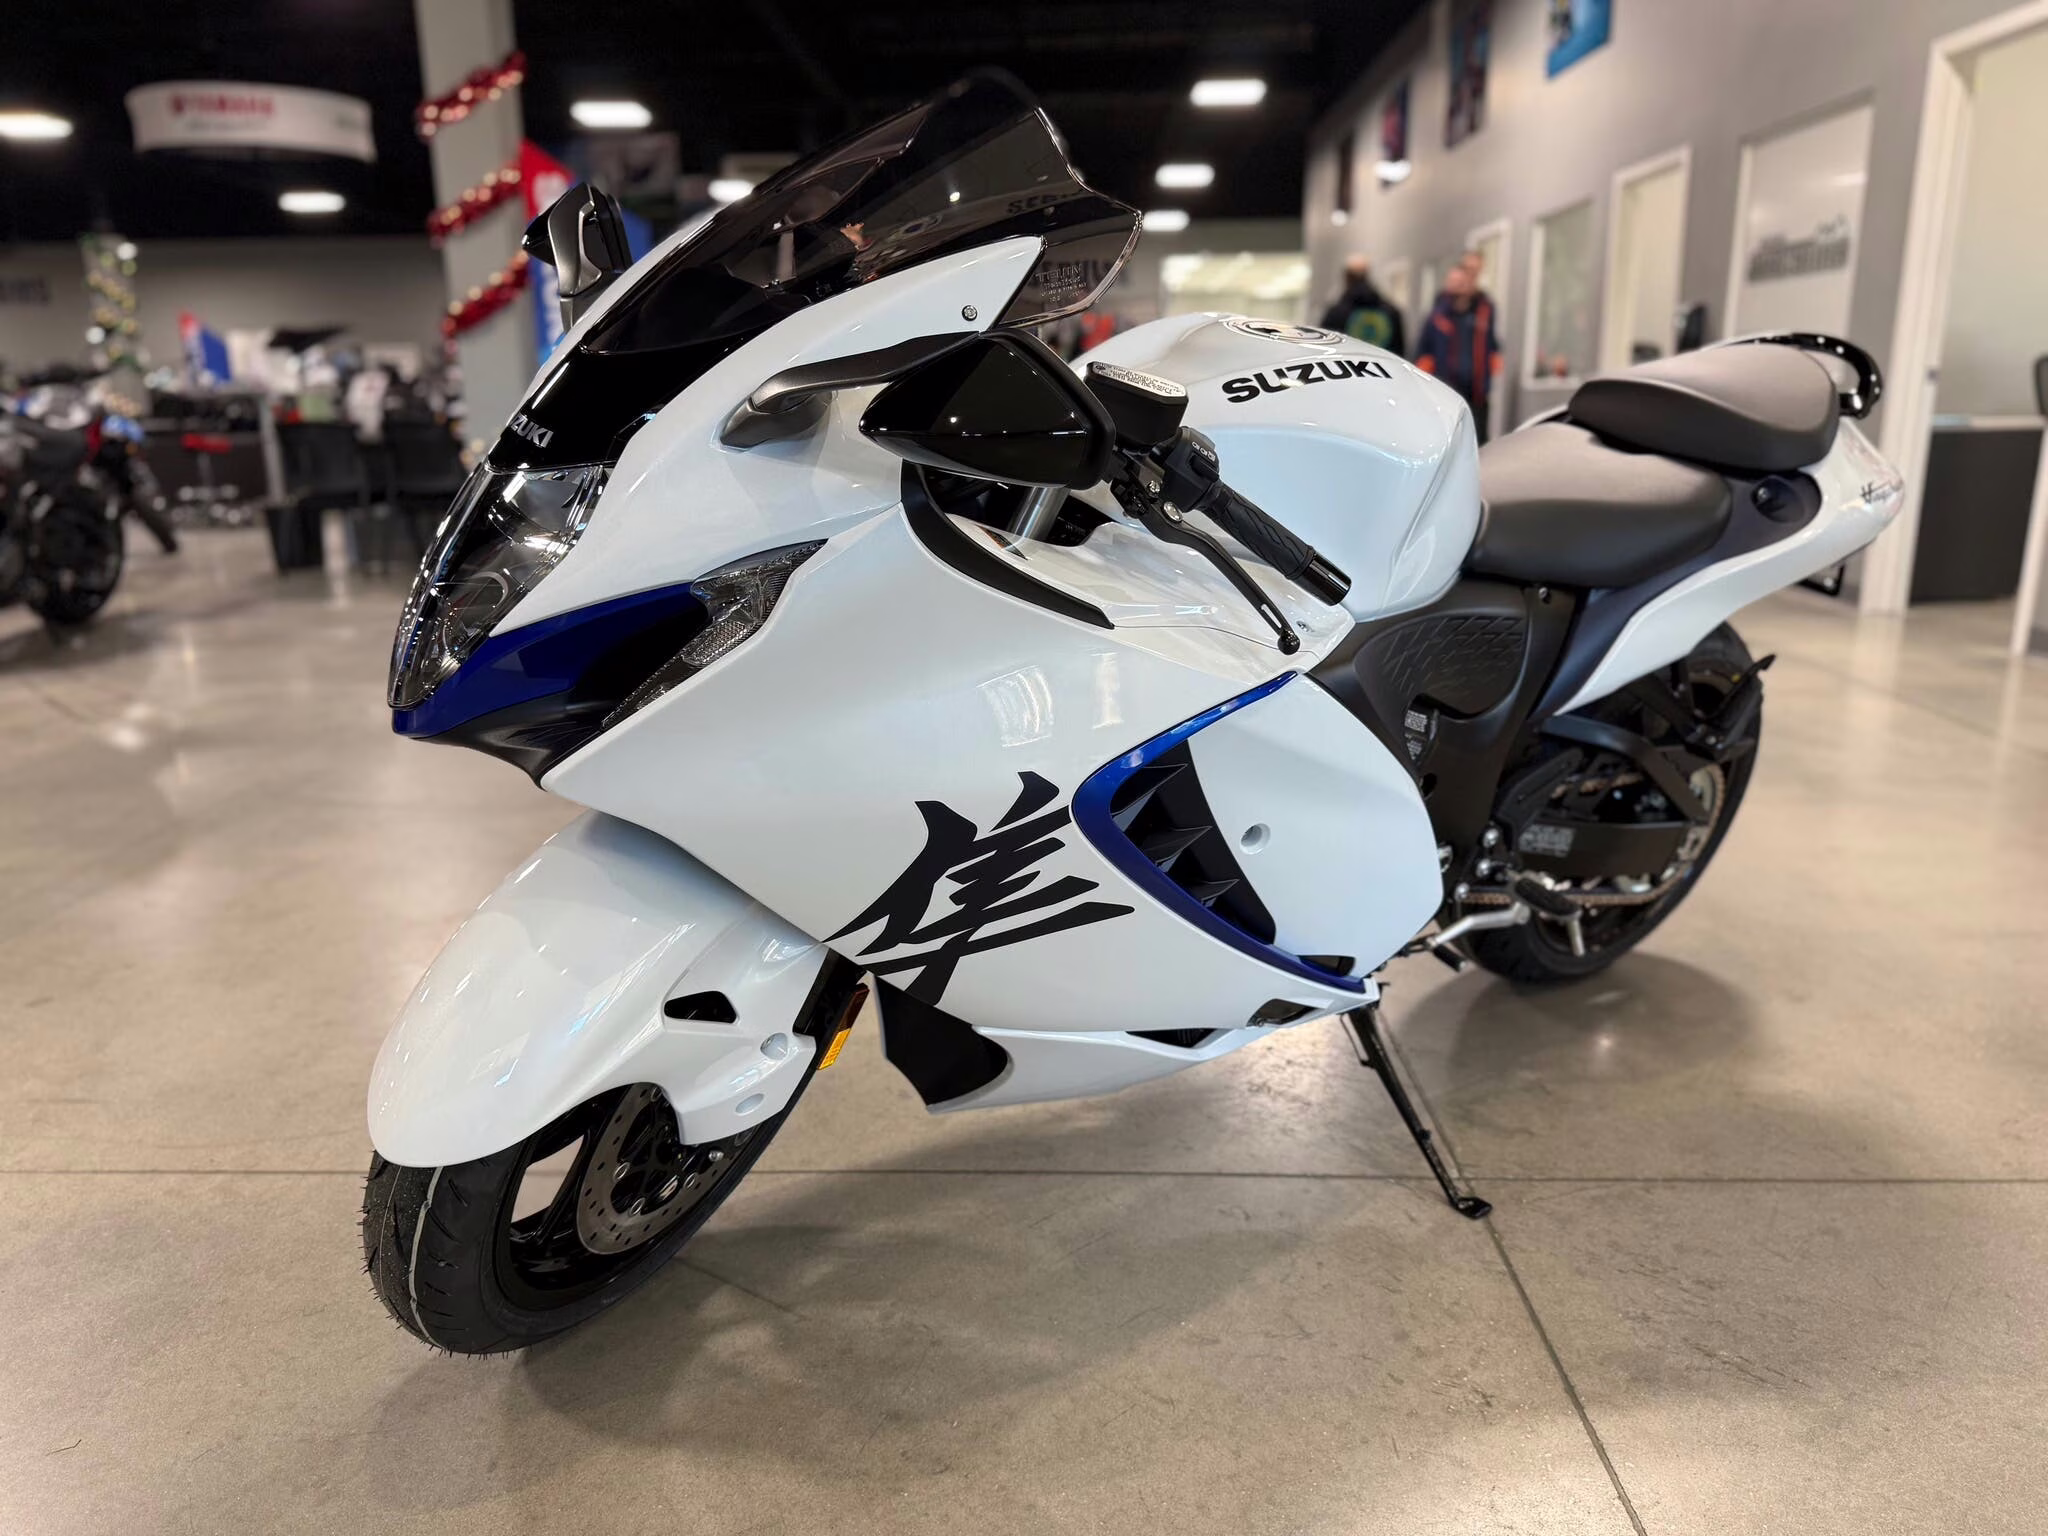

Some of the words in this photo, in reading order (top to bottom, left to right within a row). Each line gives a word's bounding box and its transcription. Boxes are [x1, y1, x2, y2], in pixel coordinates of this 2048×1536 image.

[1222, 360, 1393, 404] SUZUKI
[509, 412, 554, 449] ZUKI
[821, 770, 1135, 1007] 隼
